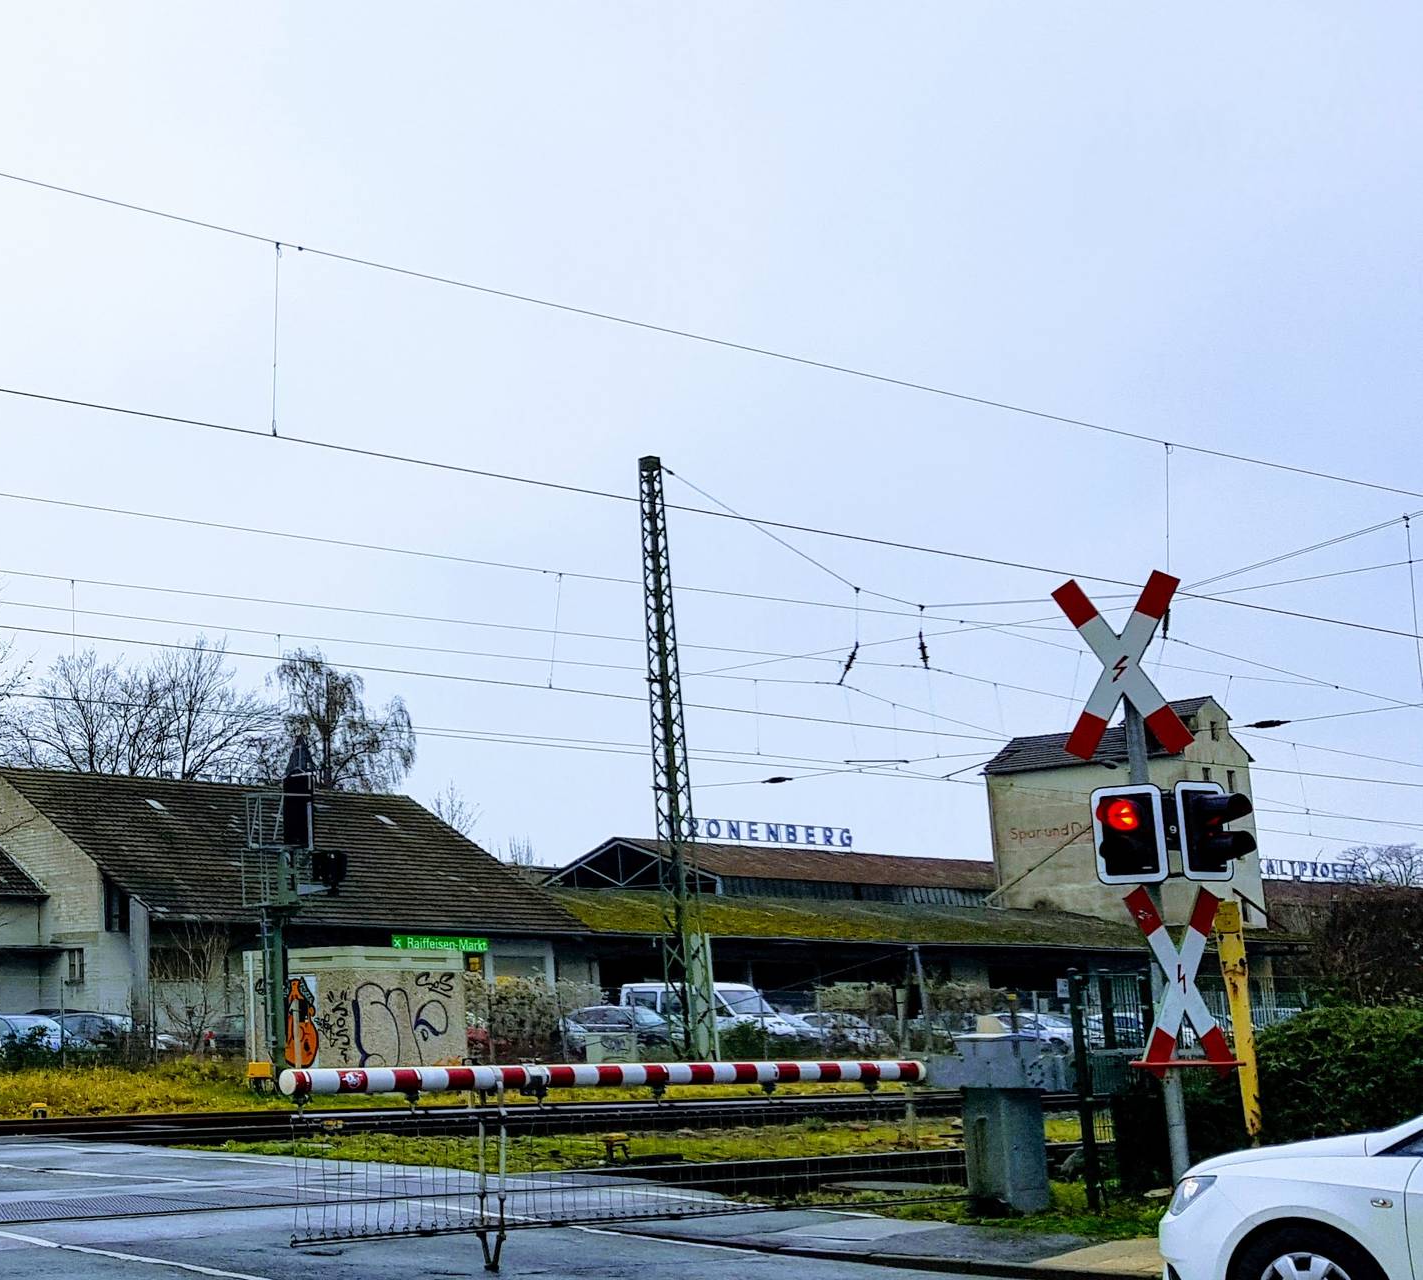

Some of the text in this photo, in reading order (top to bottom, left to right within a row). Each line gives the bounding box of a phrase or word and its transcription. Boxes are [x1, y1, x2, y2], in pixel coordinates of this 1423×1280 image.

[687, 818, 853, 848] RONENBERG
[1169, 825, 1178, 834] 9
[407, 937, 488, 951] Raiffeisen-Markt
